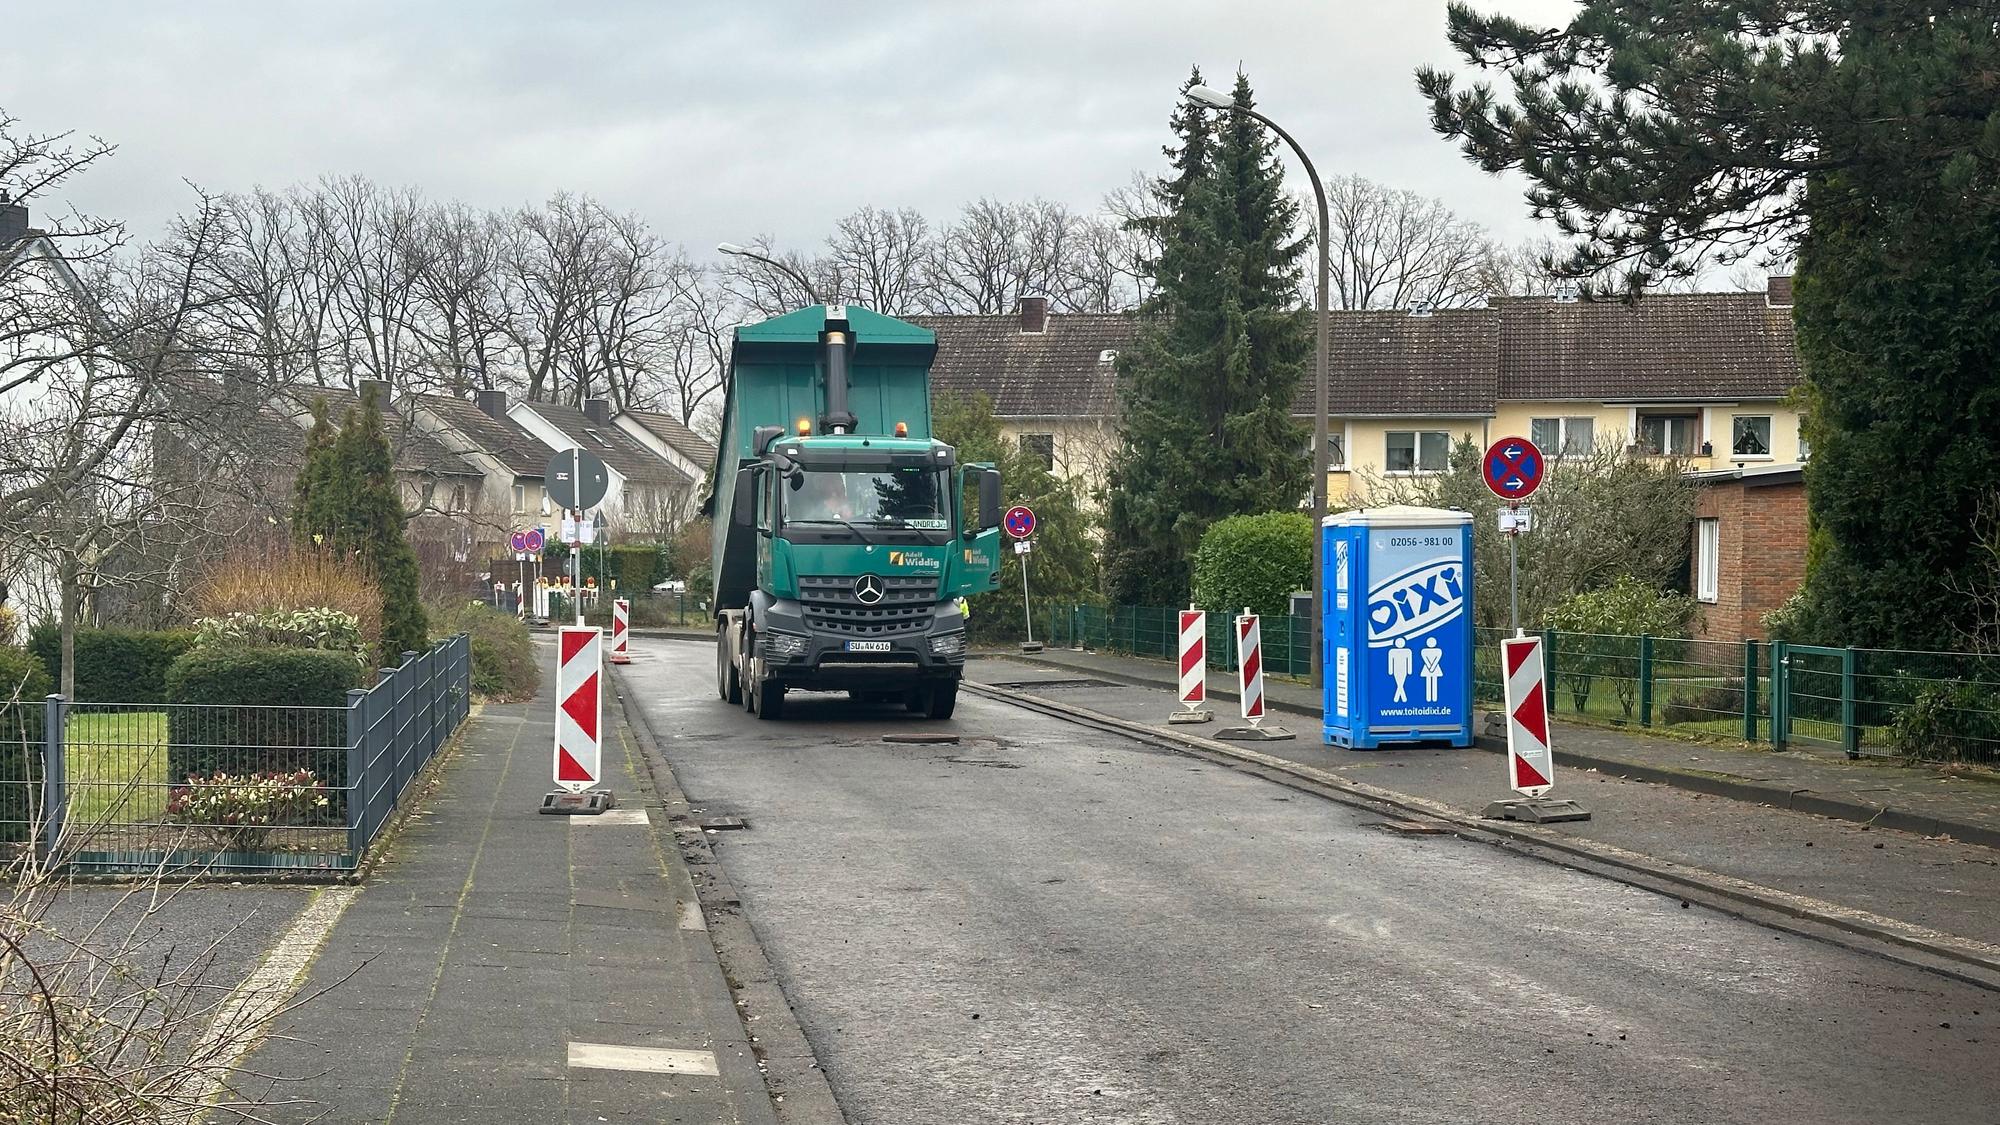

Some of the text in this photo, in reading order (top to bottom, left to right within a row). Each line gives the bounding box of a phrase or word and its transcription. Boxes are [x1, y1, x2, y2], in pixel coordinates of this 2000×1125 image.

[1391, 537, 1418, 547] 02056
[1424, 537, 1440, 546] 981
[1442, 537, 1453, 546] 00
[905, 558, 940, 569] Widdig
[850, 642, 890, 651] SU AW 616
[1380, 706, 1452, 717] www.toitoidixi.de
